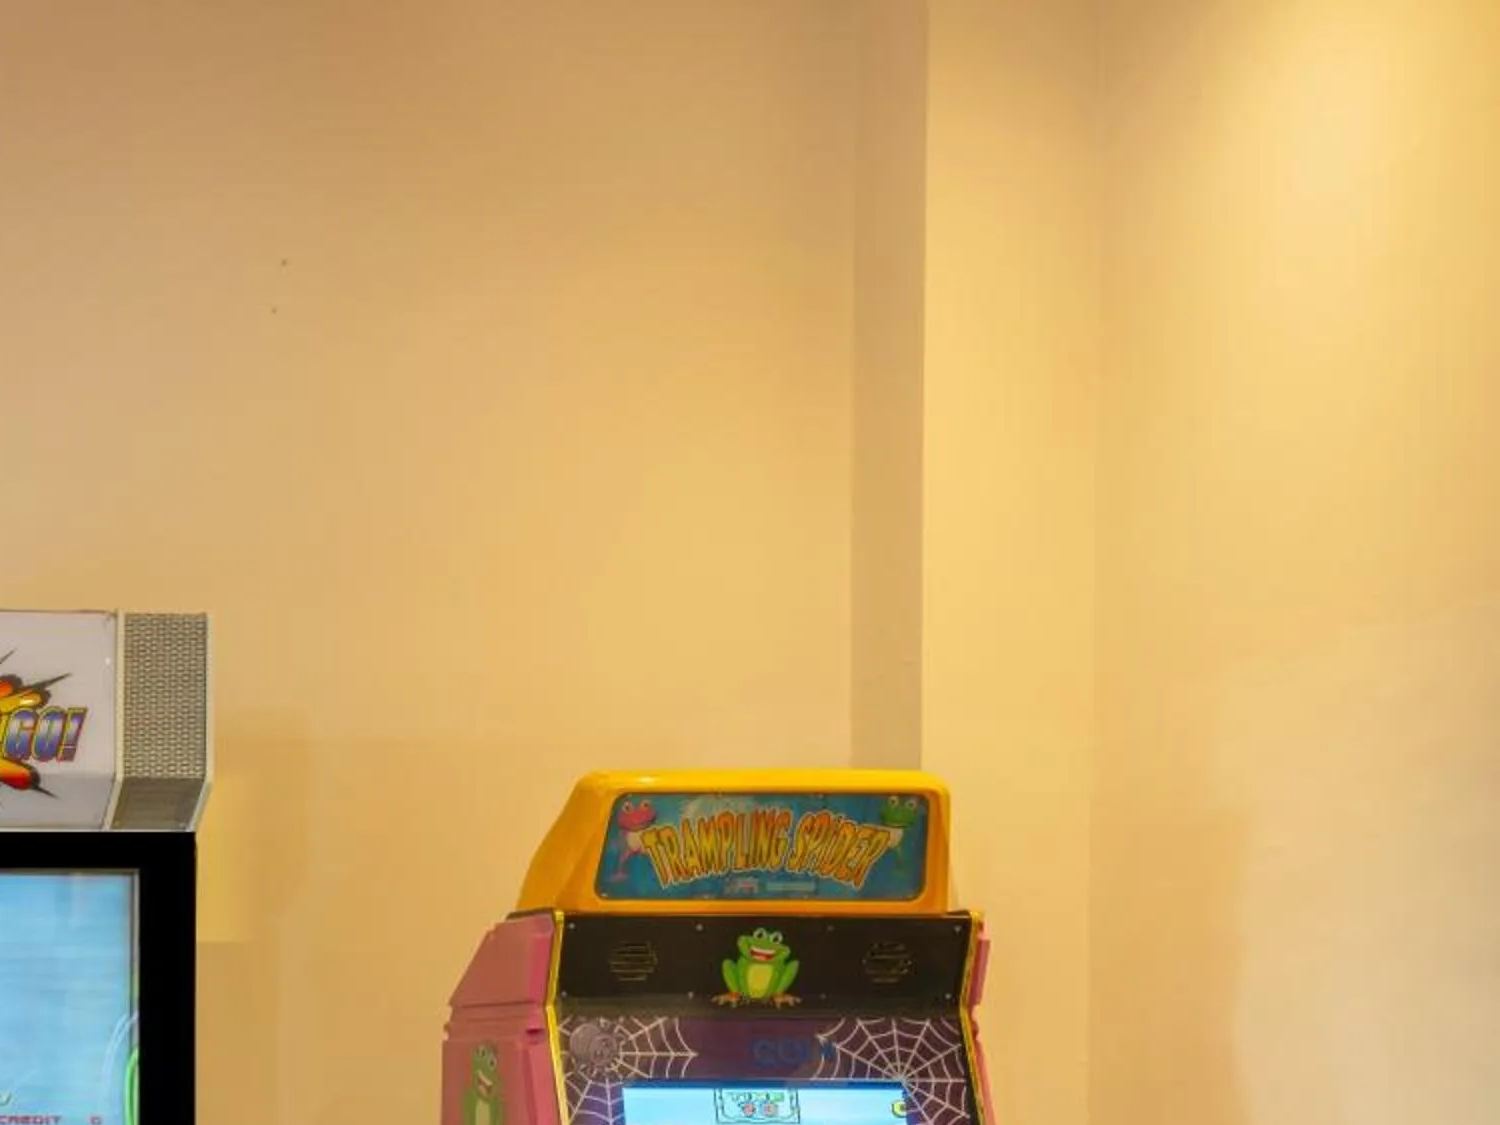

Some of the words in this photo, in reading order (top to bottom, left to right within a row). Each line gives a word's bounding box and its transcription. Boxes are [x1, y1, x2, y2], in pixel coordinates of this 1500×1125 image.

[0, 705, 88, 763] GO!
[639, 808, 793, 889] TRAMPLING
[788, 810, 893, 890] SPIDER
